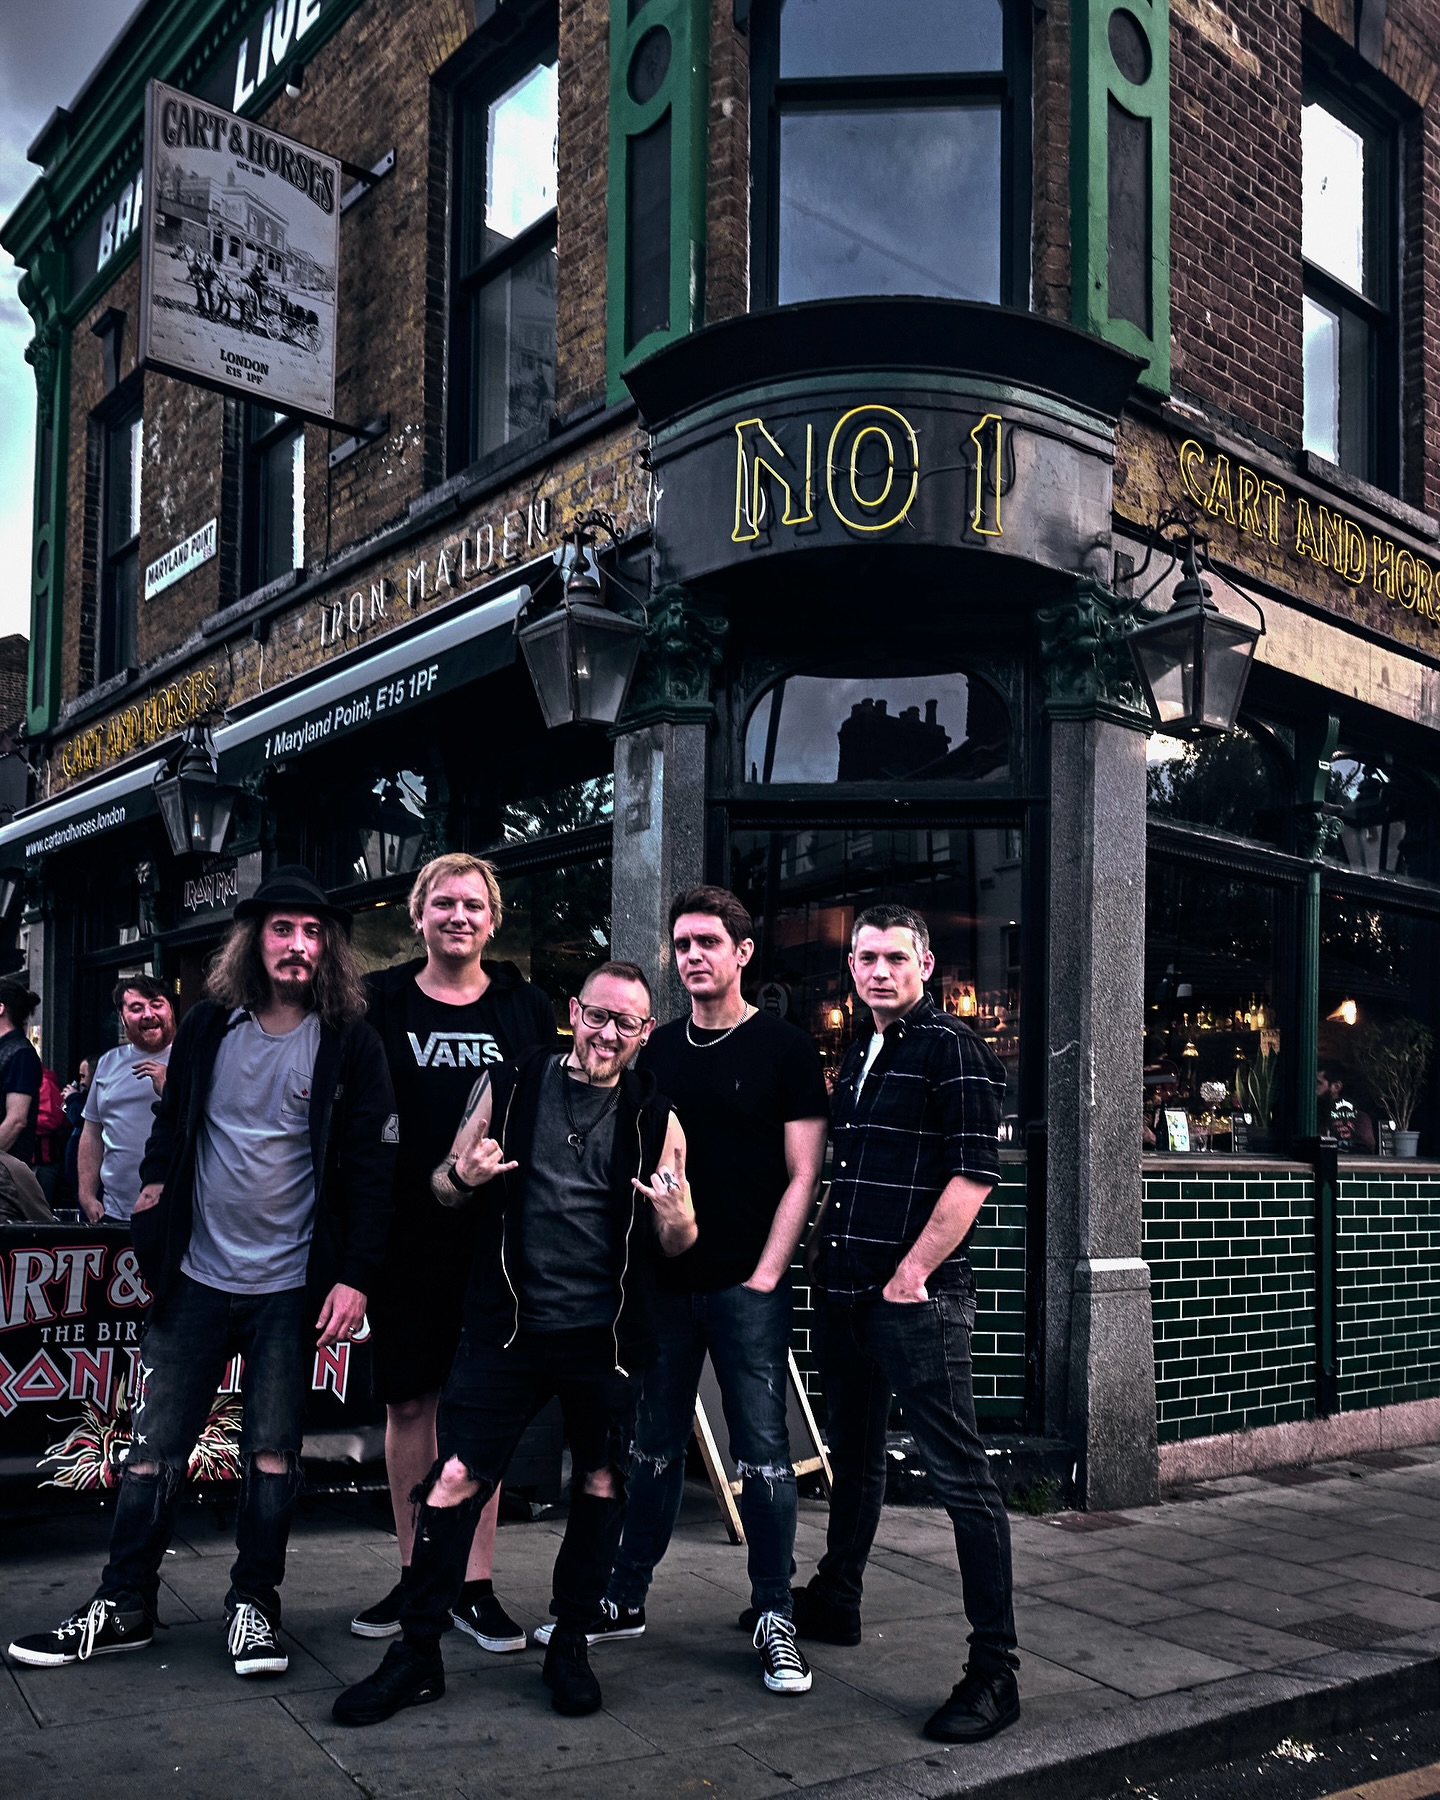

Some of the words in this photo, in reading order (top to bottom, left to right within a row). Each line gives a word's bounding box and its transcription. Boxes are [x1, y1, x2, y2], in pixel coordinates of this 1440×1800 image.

[161, 99, 229, 152] CART
[227, 123, 248, 158] &
[246, 126, 335, 216] HORSES
[220, 348, 270, 376] LONDON
[225, 364, 242, 379] E15
[246, 371, 264, 386] 1PF
[731, 404, 919, 542] NO
[970, 413, 1003, 536] 1
[1180, 439, 1286, 546] CART
[1296, 497, 1367, 584] AND
[147, 542, 189, 588] MARYLAND
[190, 523, 214, 558] POINT
[320, 578, 388, 647] IRON
[406, 497, 550, 602] MAIDEN
[62, 723, 105, 777] CART
[105, 704, 141, 761] AND
[143, 664, 218, 744] HORSES
[264, 738, 271, 759] 1
[273, 710, 333, 756] Maryland
[333, 694, 372, 731] Point,
[375, 678, 405, 713] E15
[408, 663, 439, 699] 1PF
[25, 805, 126, 858] www.cartandhorses.london
[406, 1030, 504, 1068] VANS
[108, 1247, 153, 1308] &
[40, 1323, 86, 1344] THE
[96, 1320, 146, 1342] BIR
